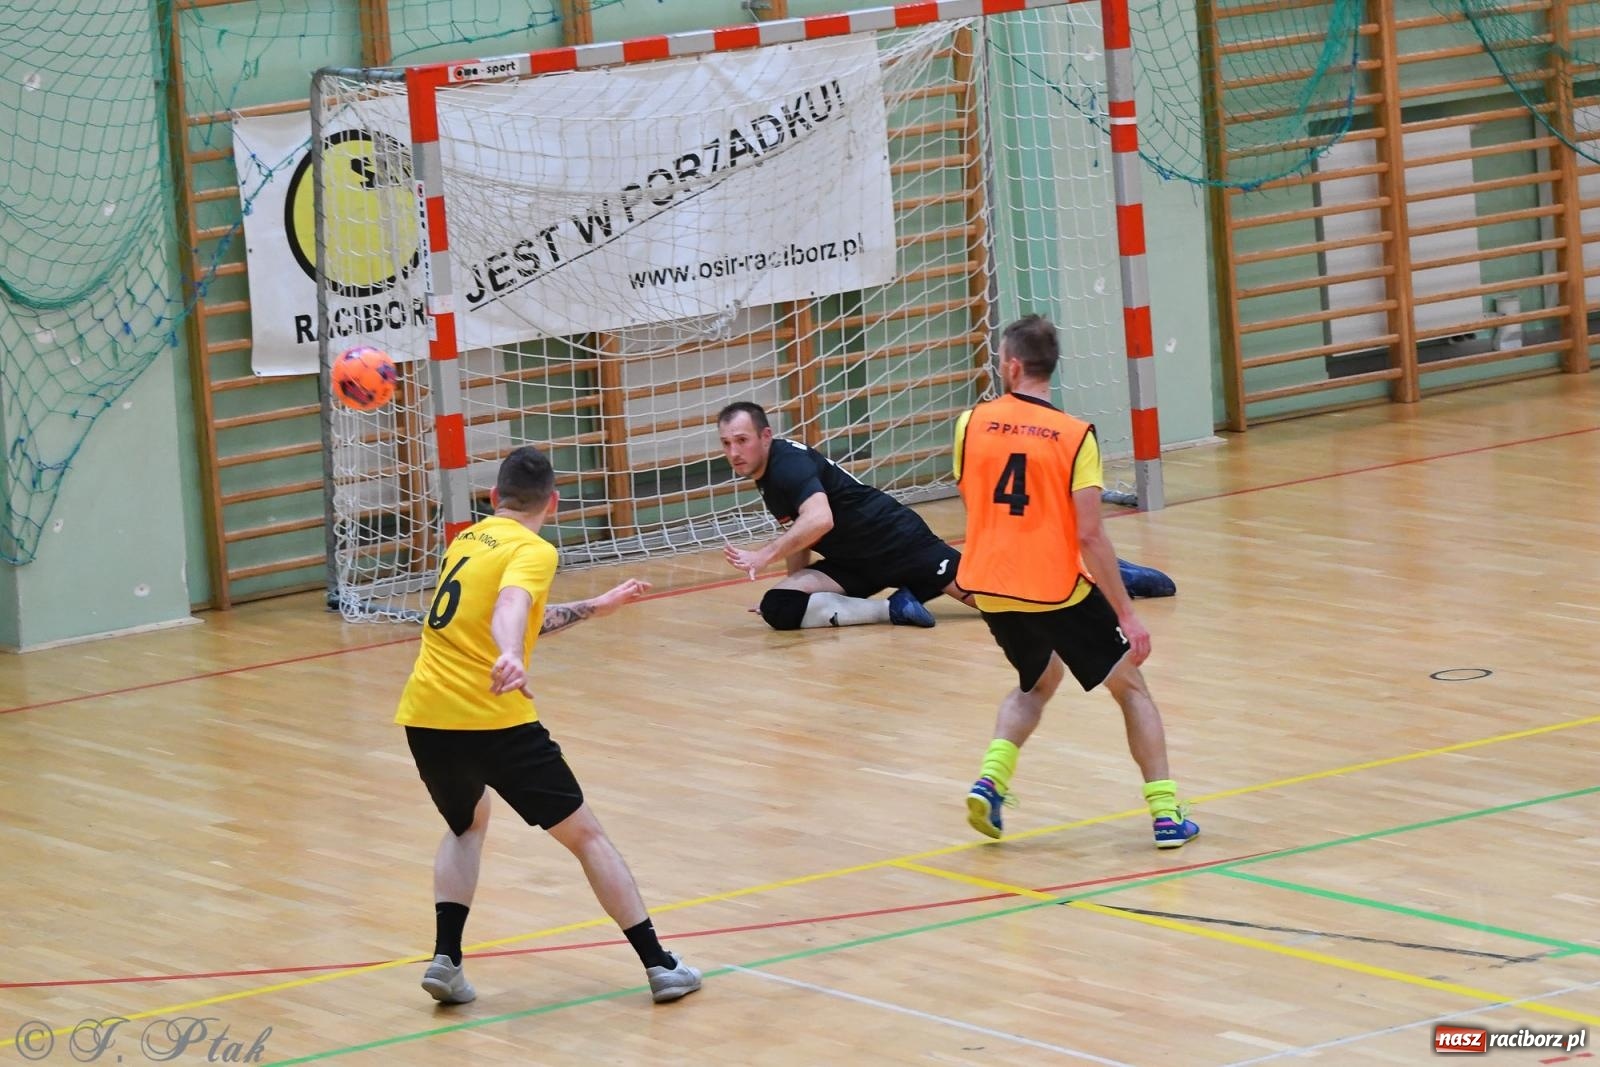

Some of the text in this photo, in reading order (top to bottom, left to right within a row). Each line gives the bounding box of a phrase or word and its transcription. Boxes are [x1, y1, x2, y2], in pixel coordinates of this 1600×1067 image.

[486, 61, 516, 75] sport
[466, 224, 560, 304] JEST
[572, 199, 613, 244] W
[628, 232, 865, 290] www.osir-raciborz.pl
[1002, 423, 1060, 442] PATRICK
[993, 453, 1030, 516] 4
